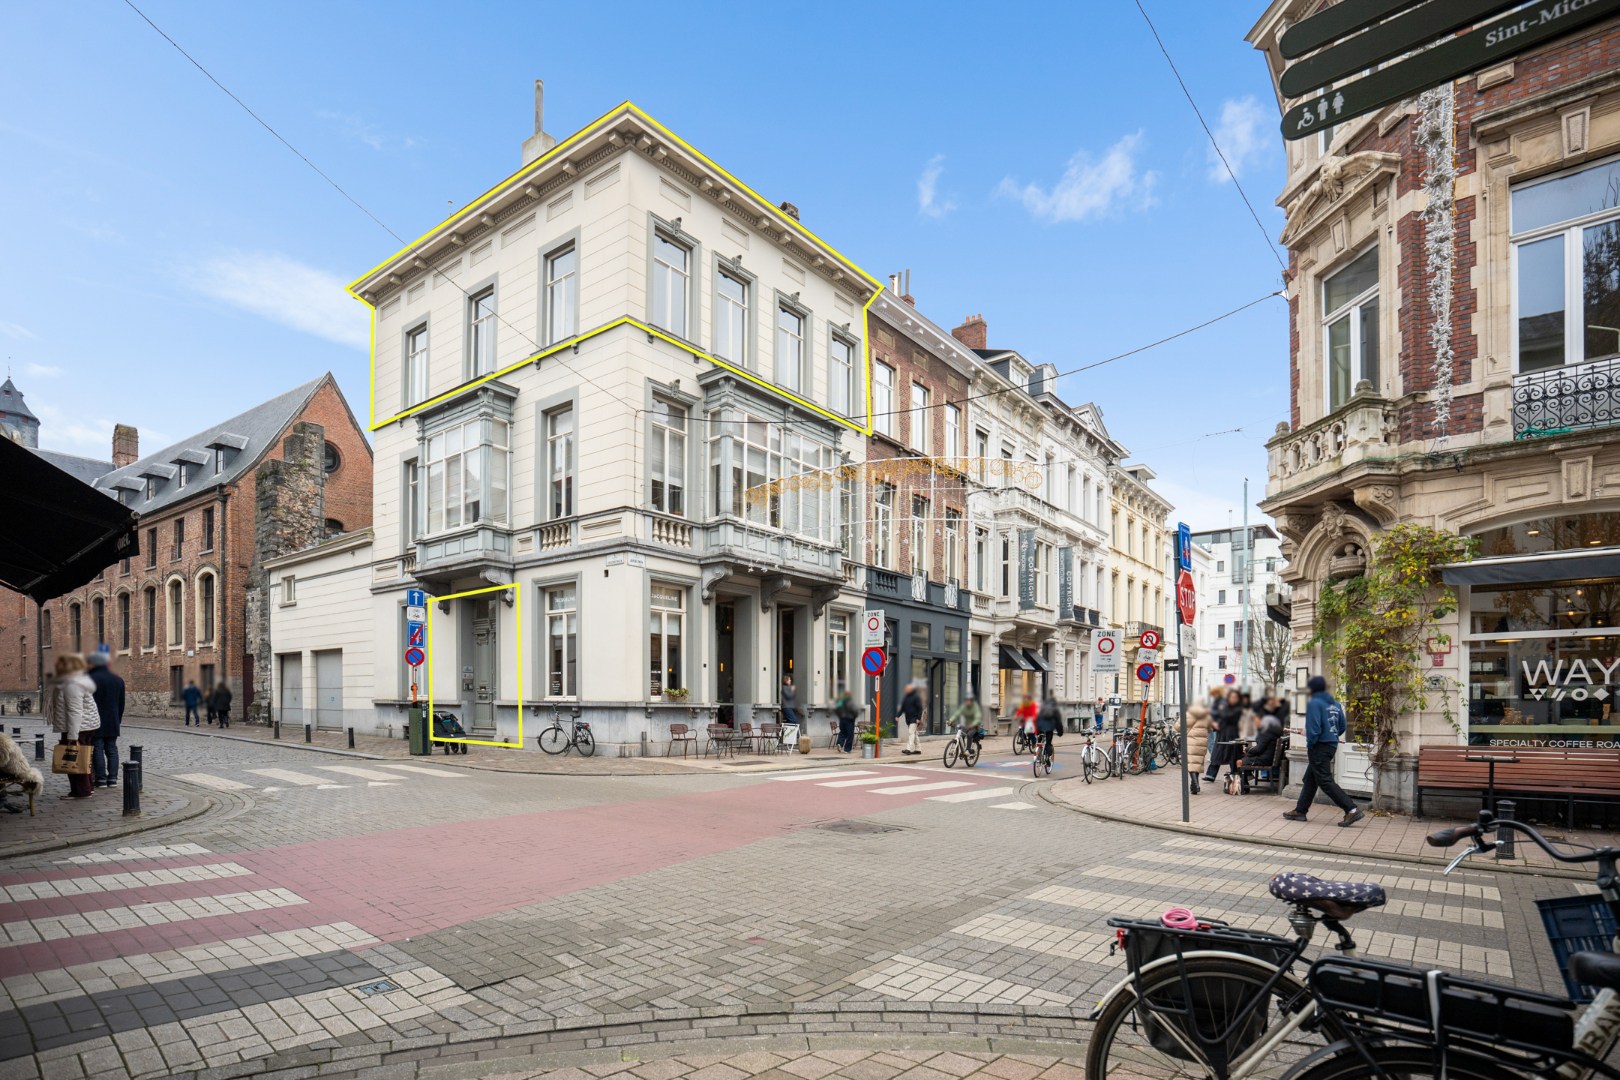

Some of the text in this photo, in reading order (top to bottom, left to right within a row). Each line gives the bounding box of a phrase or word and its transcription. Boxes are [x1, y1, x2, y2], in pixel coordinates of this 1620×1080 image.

[1180, 586, 1195, 609] STOP
[1522, 658, 1620, 686] WAY
[1489, 739, 1547, 747] SPECIALTY
[1548, 740, 1593, 748] COFFEE
